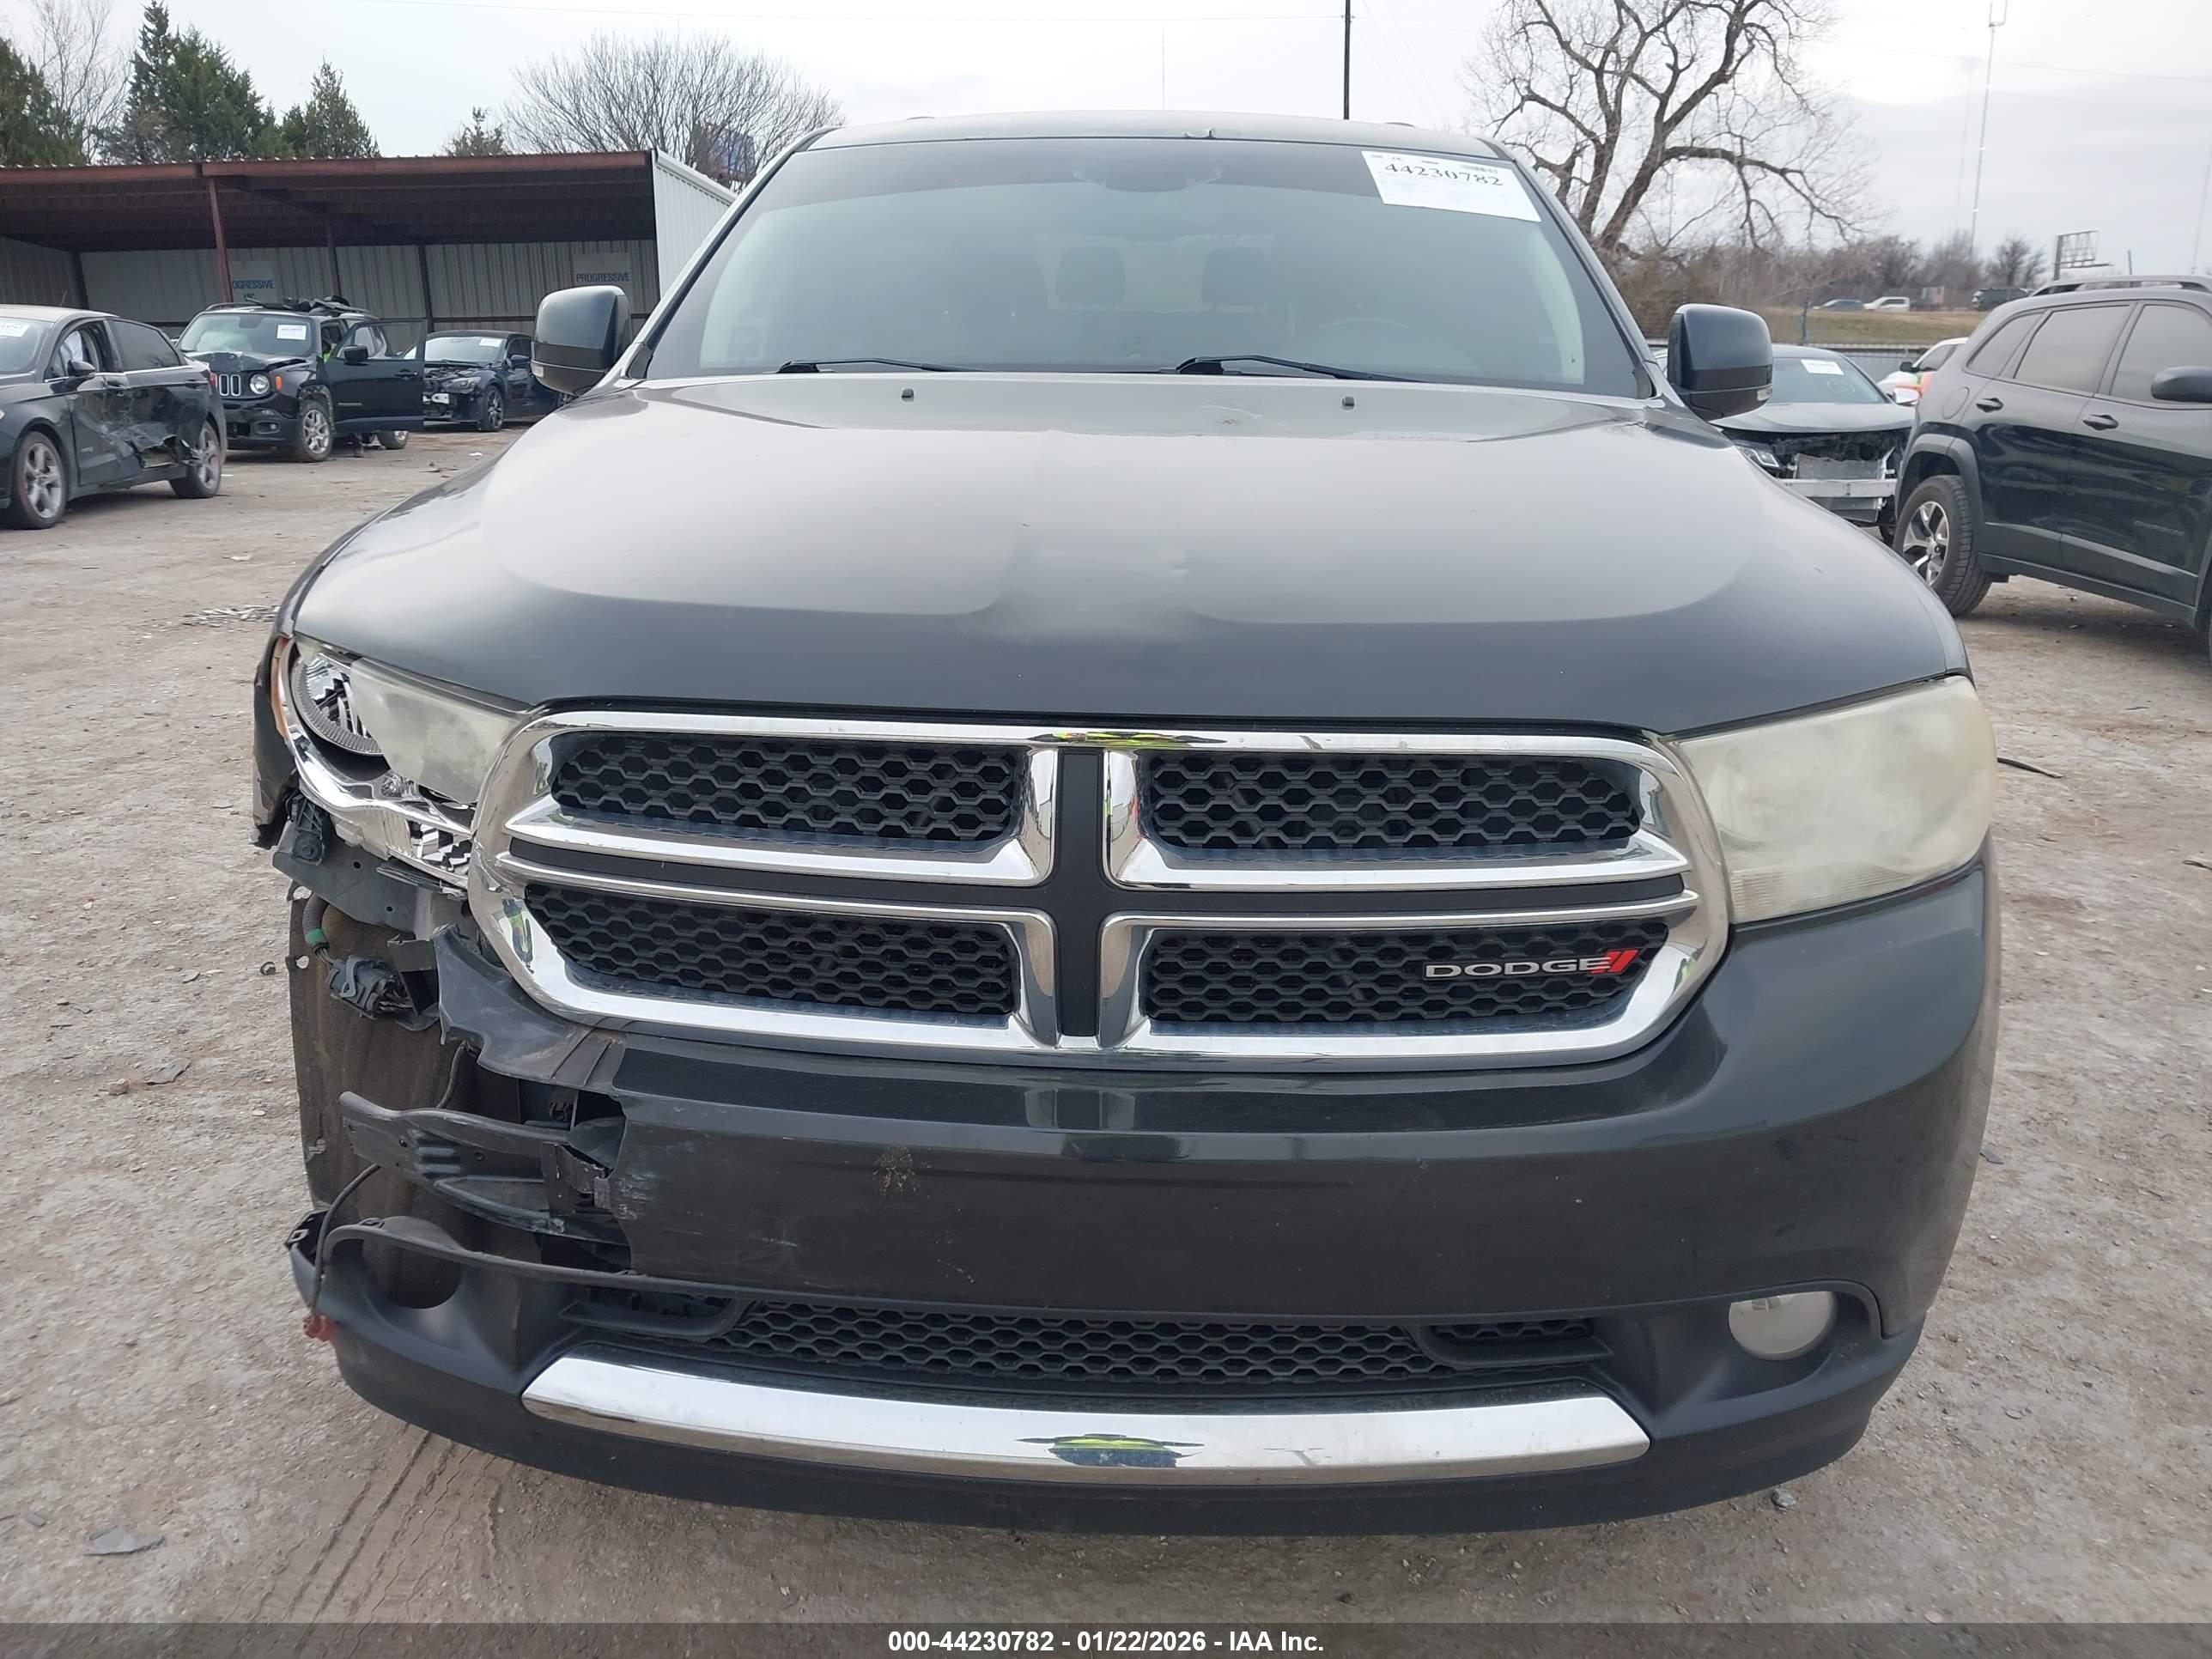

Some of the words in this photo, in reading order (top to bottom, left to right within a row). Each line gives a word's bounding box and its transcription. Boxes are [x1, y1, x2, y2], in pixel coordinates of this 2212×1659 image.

[1384, 163, 1504, 186] 44230782
[233, 279, 275, 289] OGRESSIVE
[576, 272, 631, 283] PROGRESSIVE
[1425, 956, 1612, 978] DODGE
